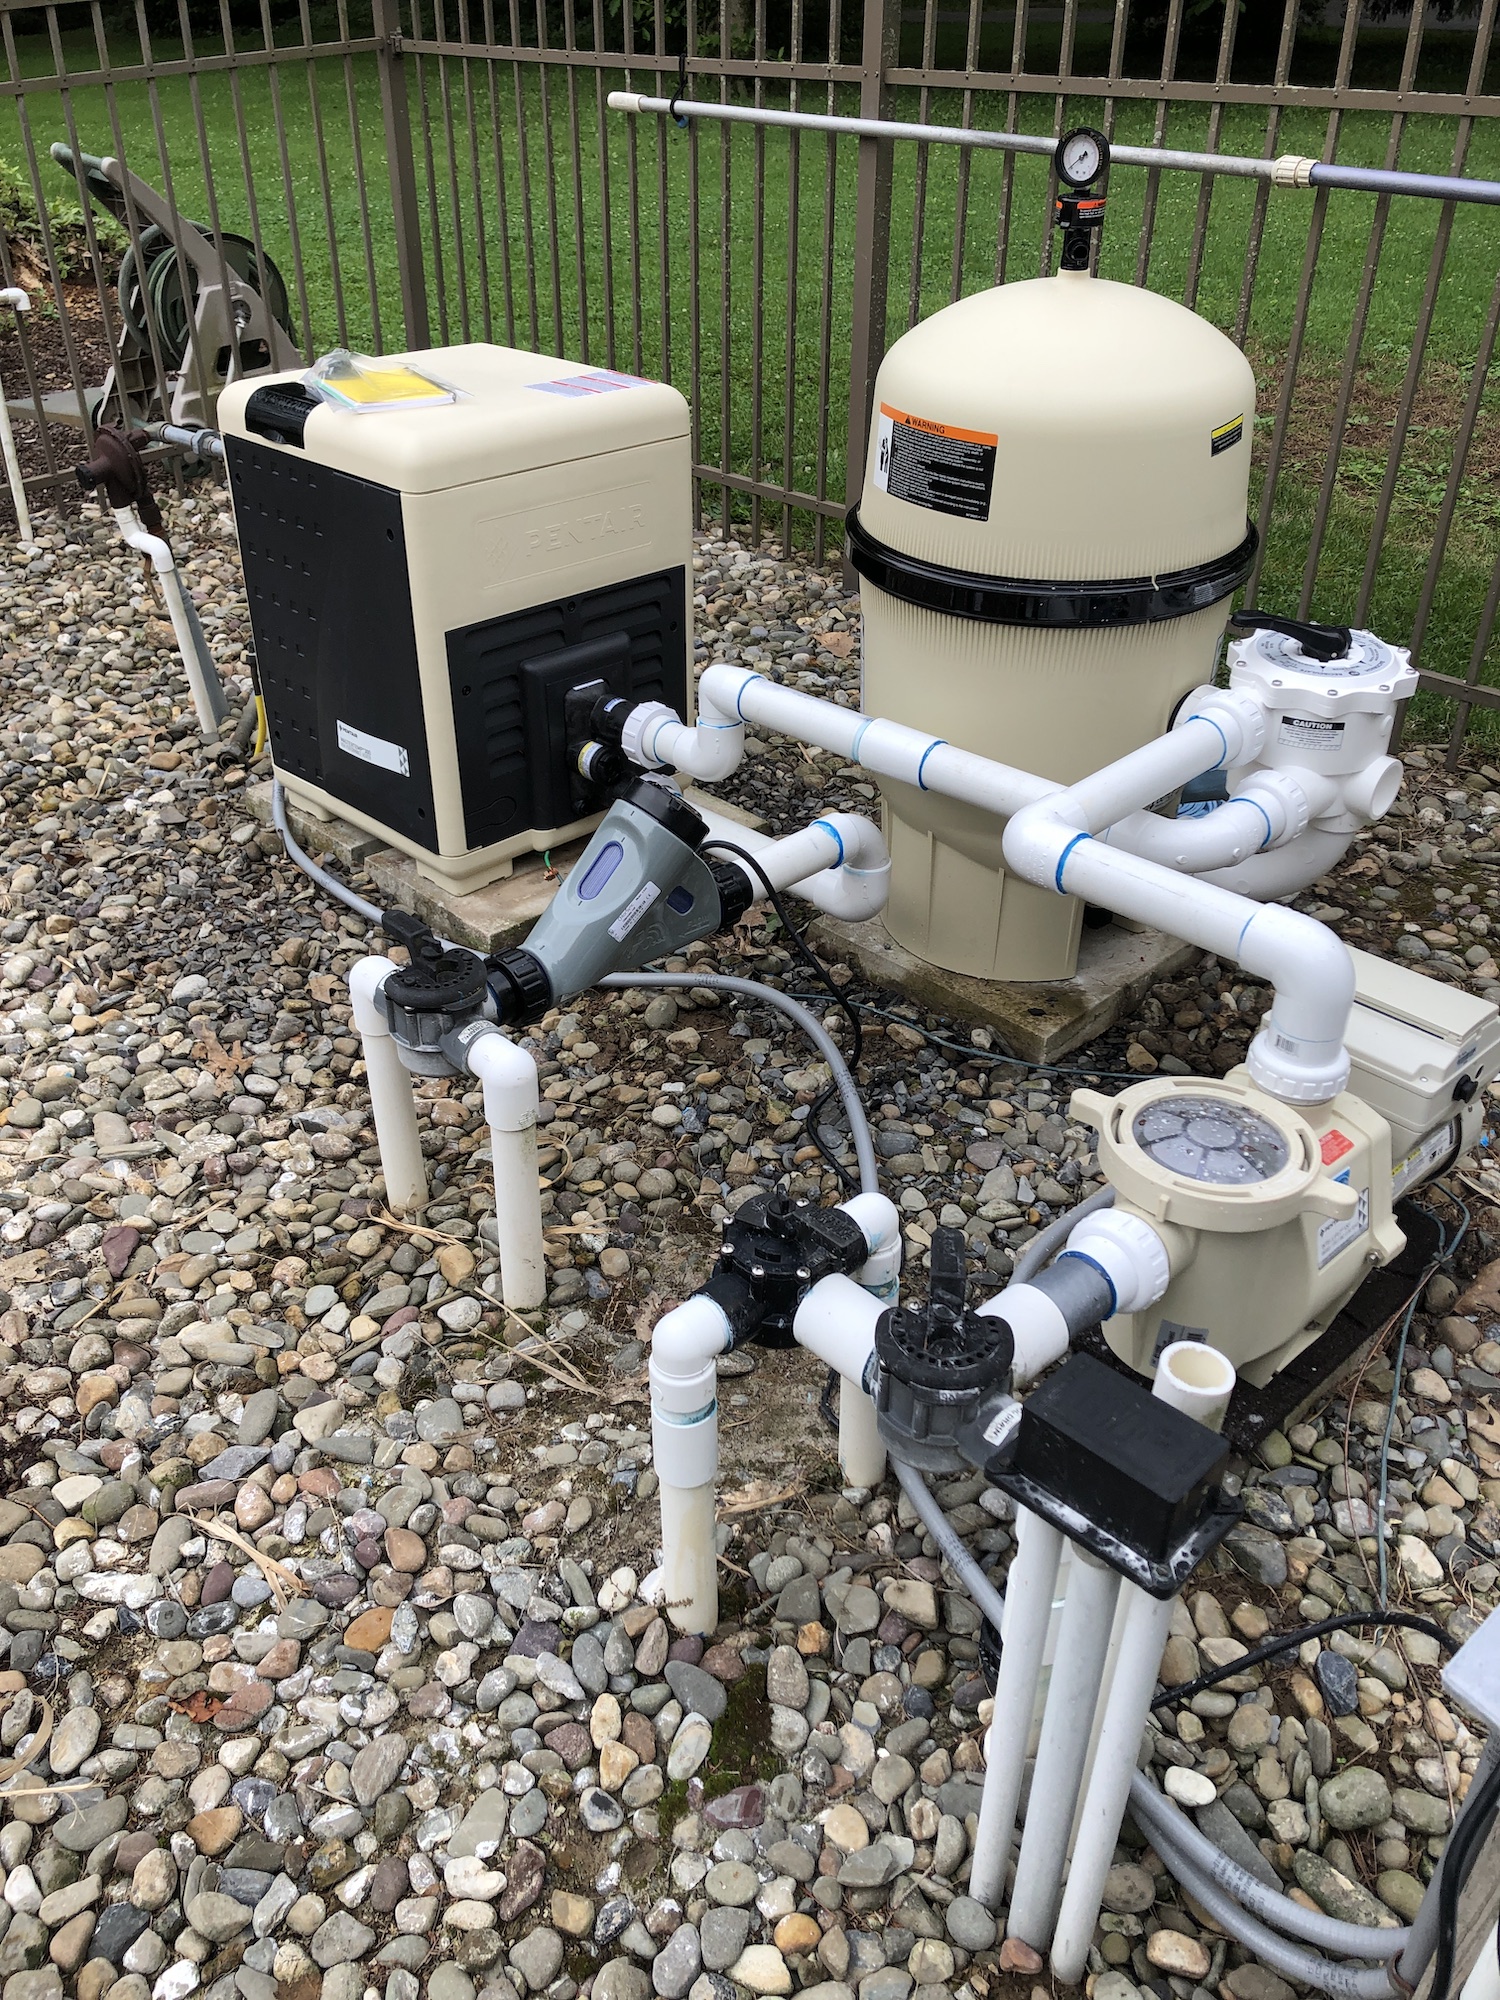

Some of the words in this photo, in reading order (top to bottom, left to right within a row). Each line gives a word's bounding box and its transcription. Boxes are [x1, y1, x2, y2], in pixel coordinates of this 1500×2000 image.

[912, 417, 945, 434] WARNING
[525, 504, 646, 557] PENTAIR
[1292, 720, 1333, 729] CAUTION
